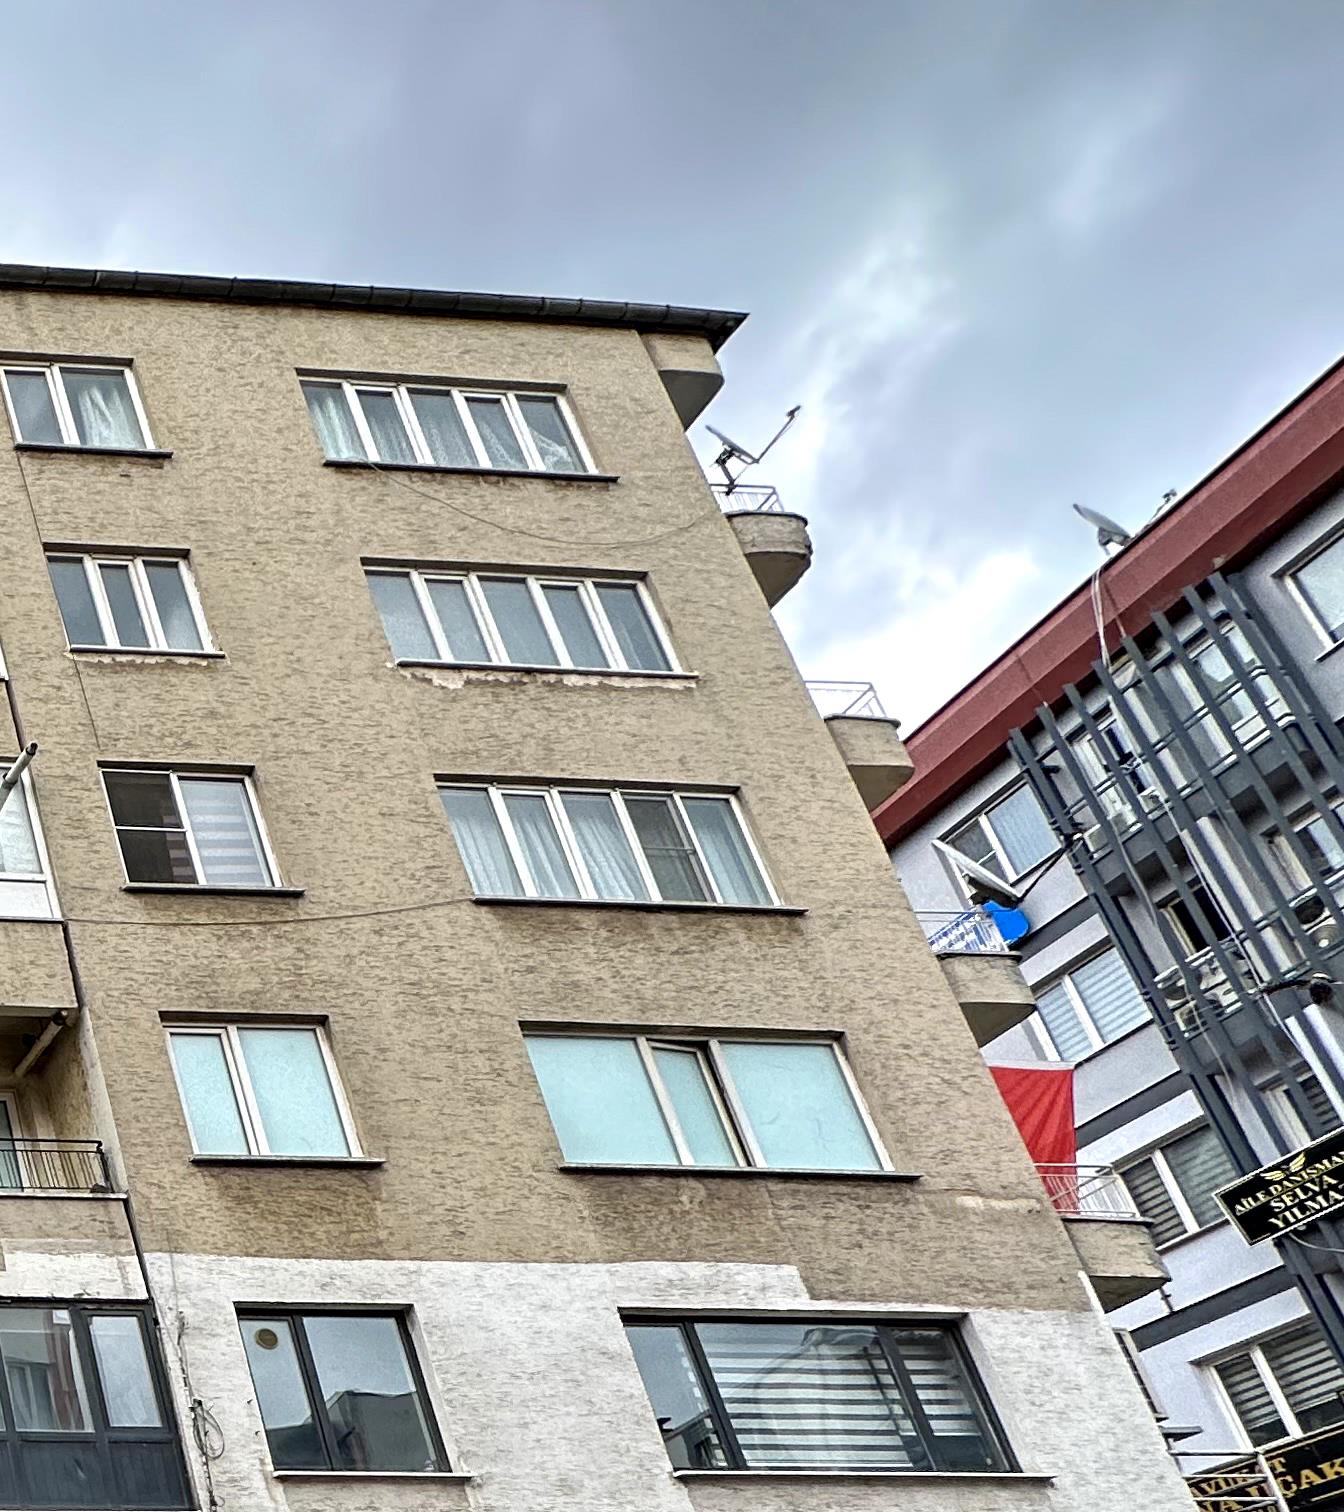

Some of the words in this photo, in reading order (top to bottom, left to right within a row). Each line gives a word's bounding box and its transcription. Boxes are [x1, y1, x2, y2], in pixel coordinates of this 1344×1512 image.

[1268, 1150, 1344, 1197] DANIŞMA
[1269, 1174, 1339, 1212] SELVA
[1268, 1183, 1344, 1229] YILMA
